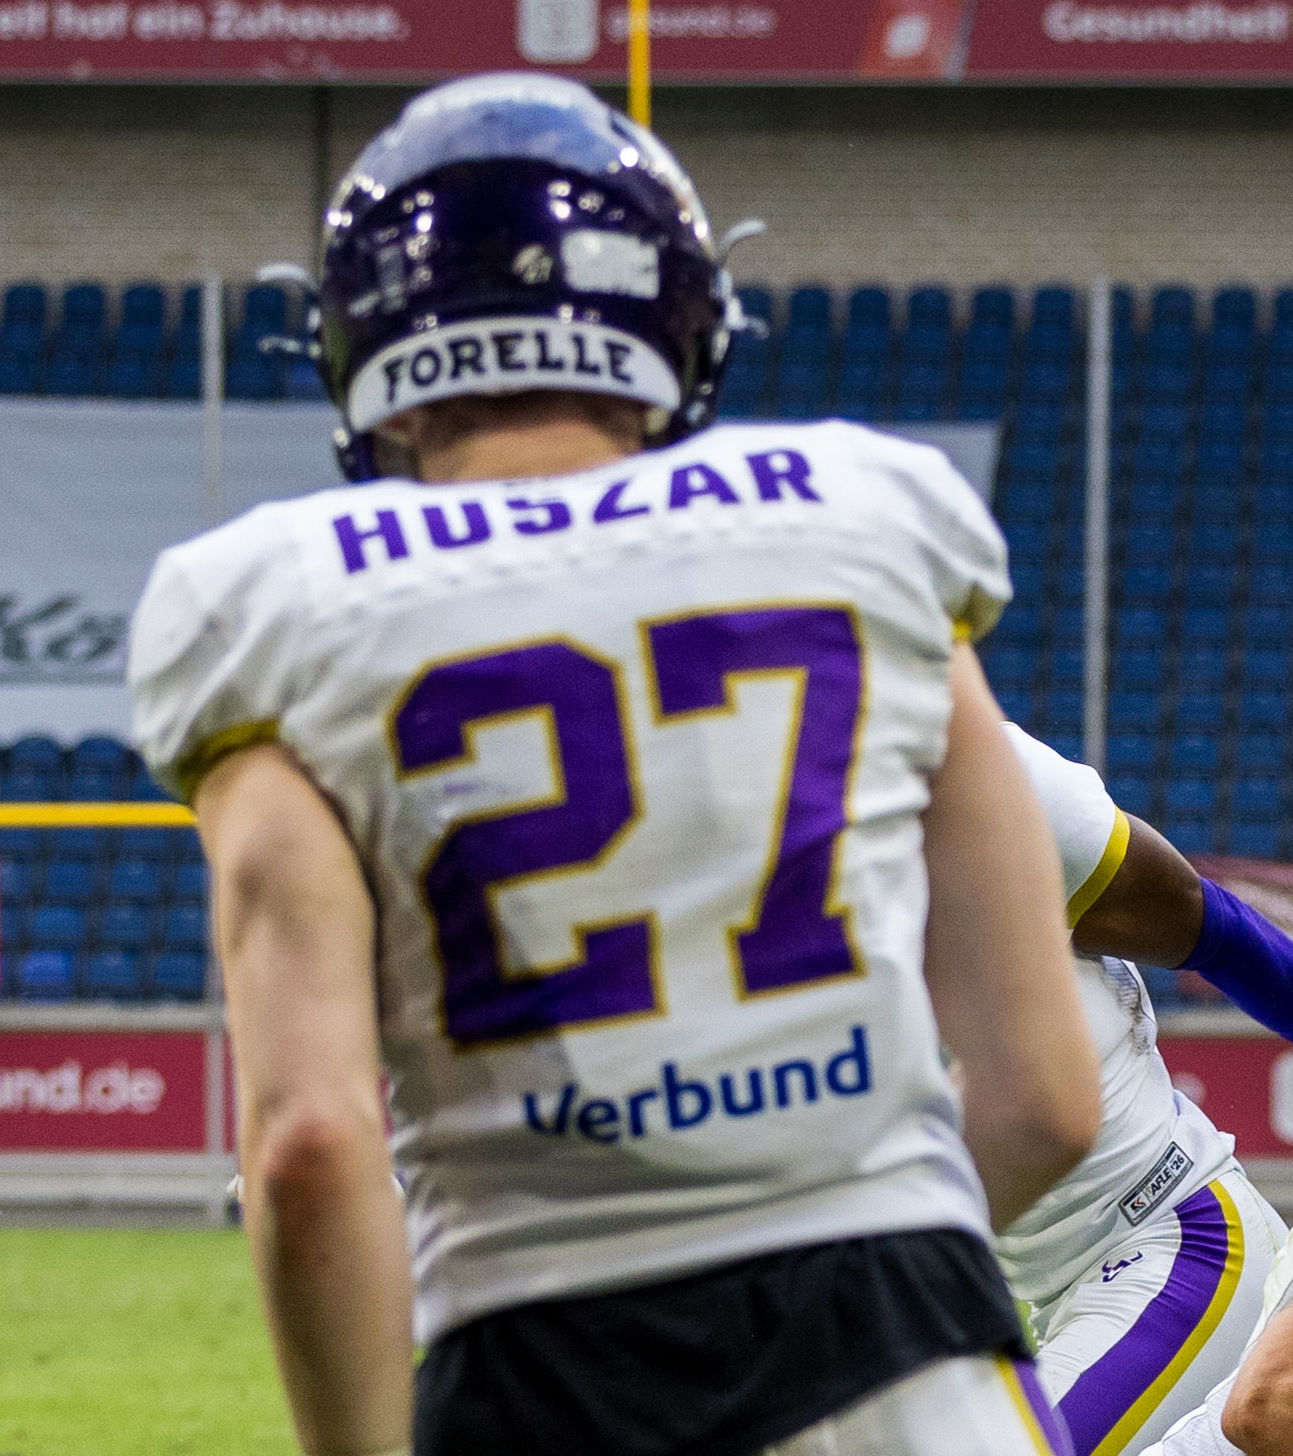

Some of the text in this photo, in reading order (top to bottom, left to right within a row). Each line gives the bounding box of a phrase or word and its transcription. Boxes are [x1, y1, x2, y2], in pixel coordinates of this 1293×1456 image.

[382, 331, 634, 401] FORELLE
[332, 447, 825, 575] HUSZAR
[385, 597, 872, 1055] 27
[522, 1023, 874, 1146] Verbund
[1150, 1167, 1173, 1197] AFLE
